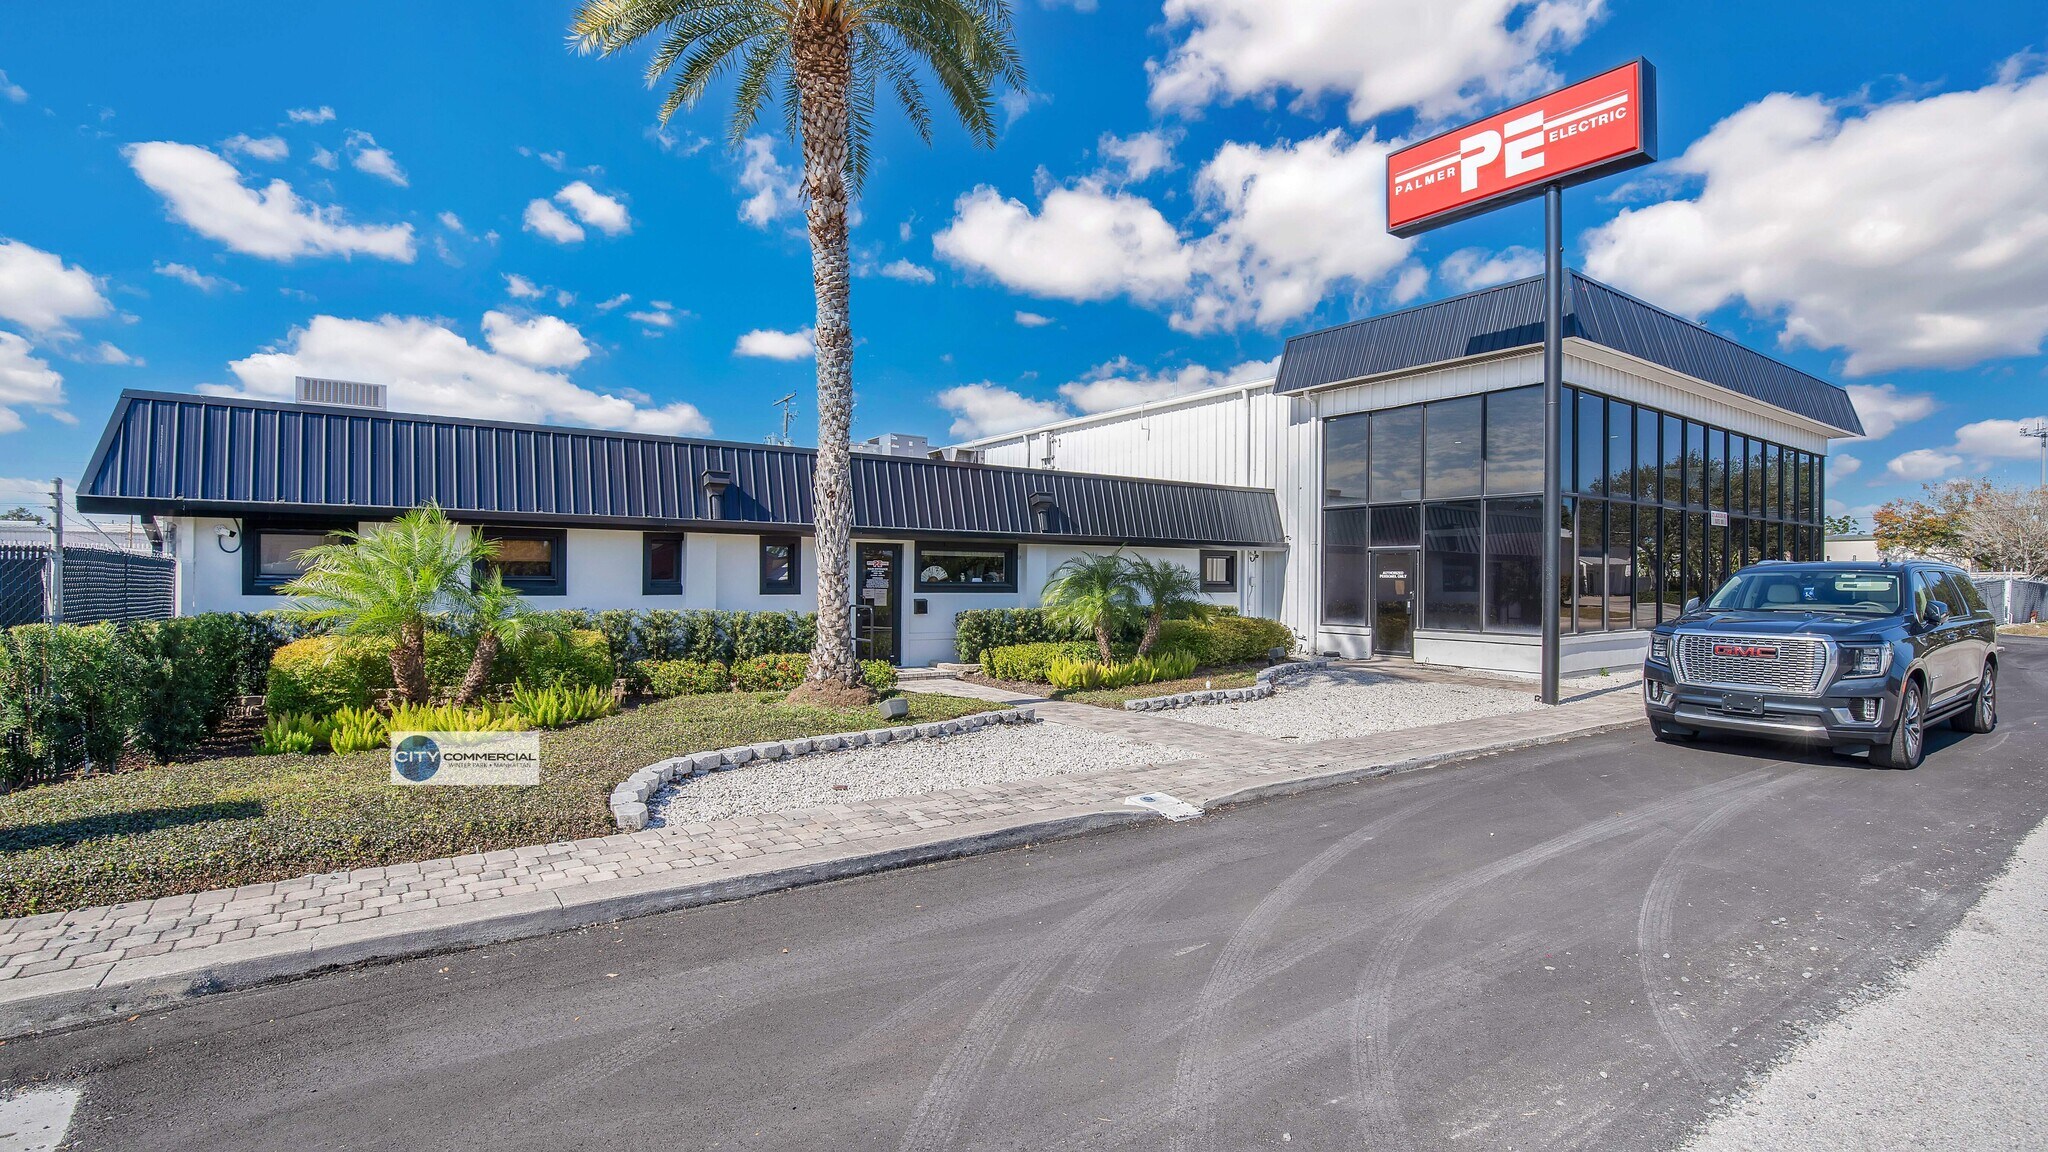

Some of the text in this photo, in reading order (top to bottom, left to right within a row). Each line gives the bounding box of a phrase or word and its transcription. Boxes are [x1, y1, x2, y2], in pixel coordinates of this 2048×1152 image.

[1395, 106, 1628, 196] PALMER PE ELECTRIC
[1714, 645, 1777, 659] GMC
